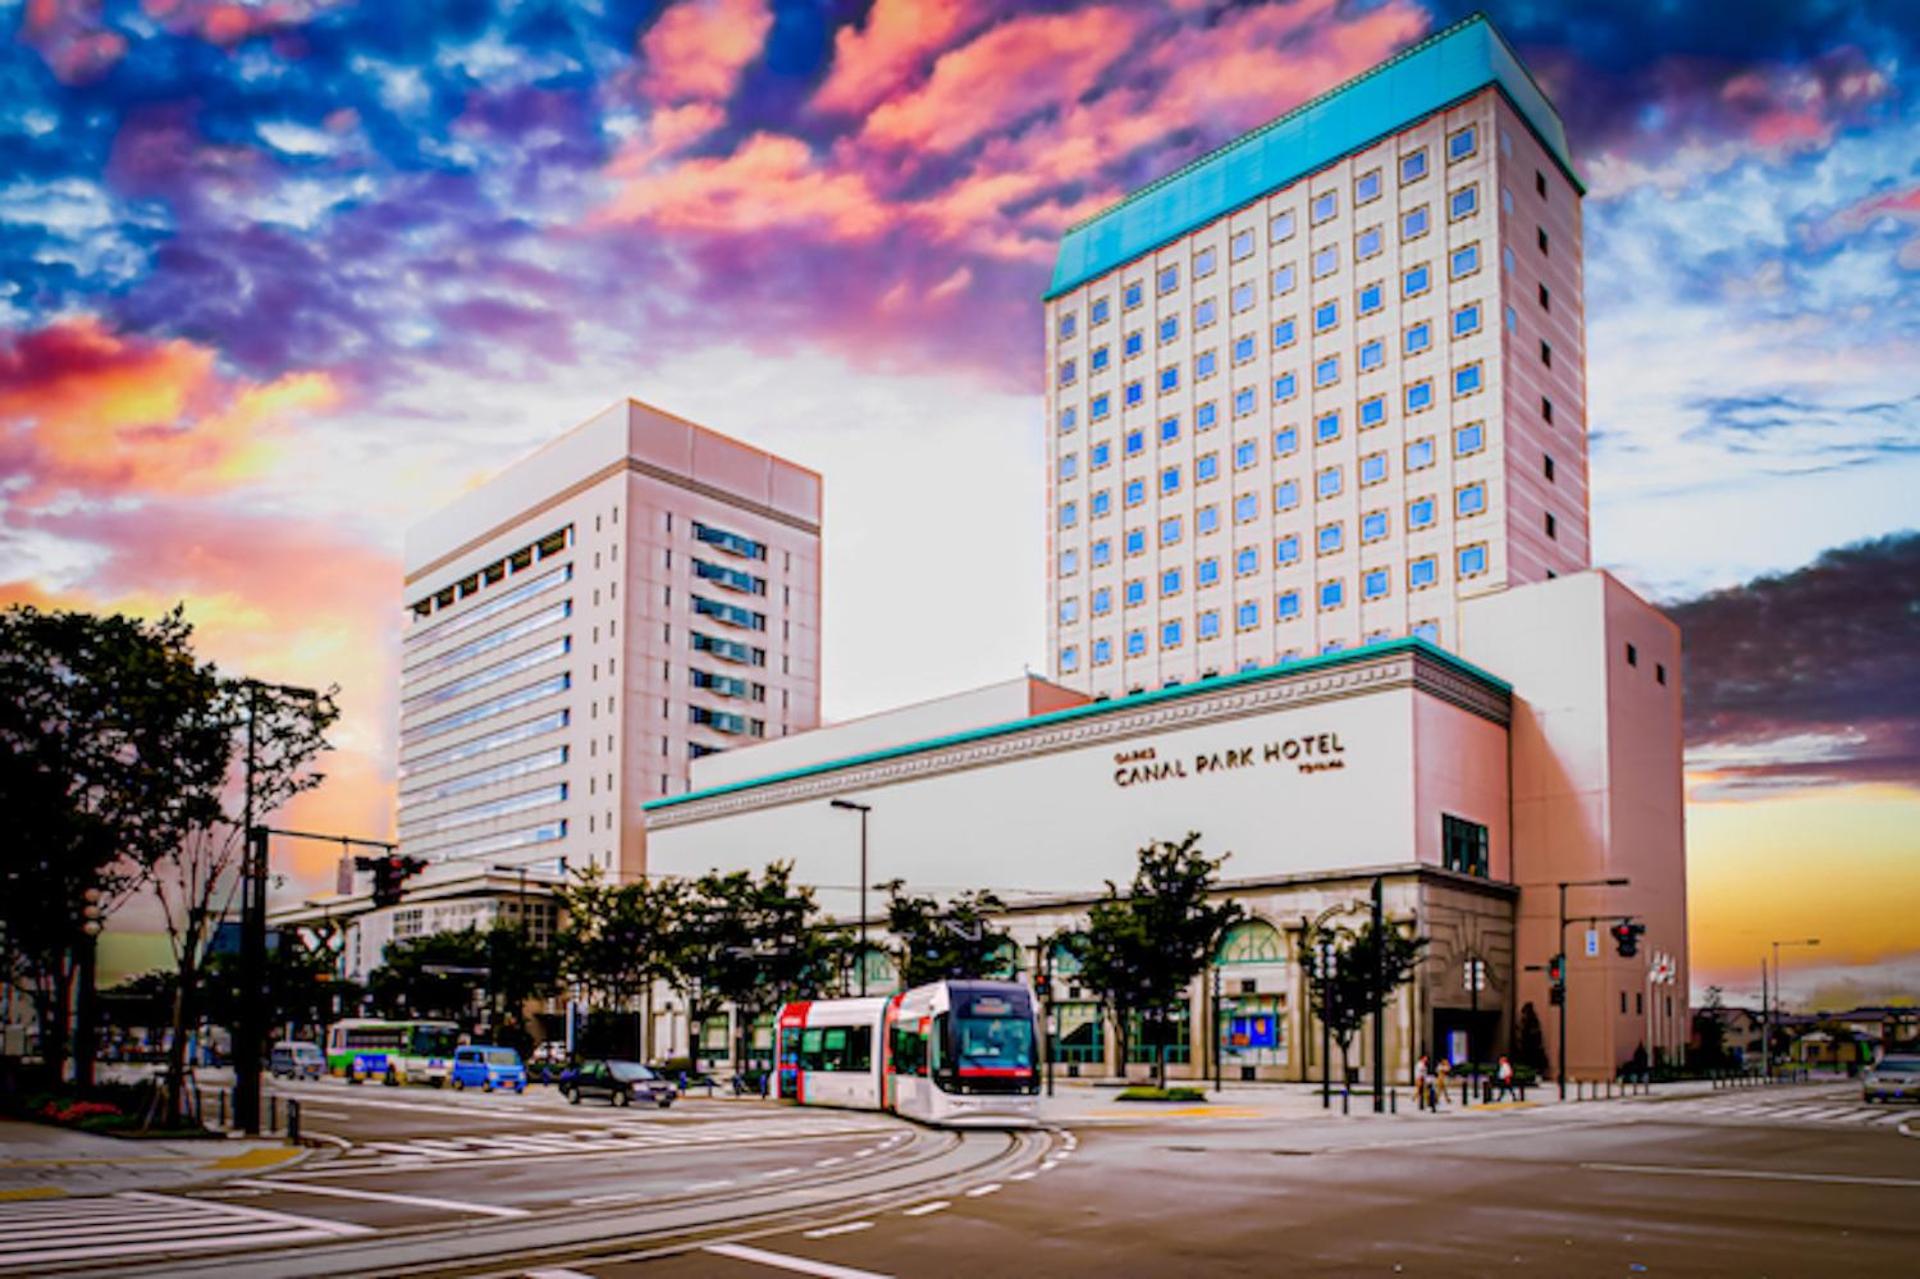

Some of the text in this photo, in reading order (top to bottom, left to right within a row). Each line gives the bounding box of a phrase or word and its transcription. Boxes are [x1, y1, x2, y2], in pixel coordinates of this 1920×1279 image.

[1114, 732, 1345, 787] CANAL PARK HOTEL
